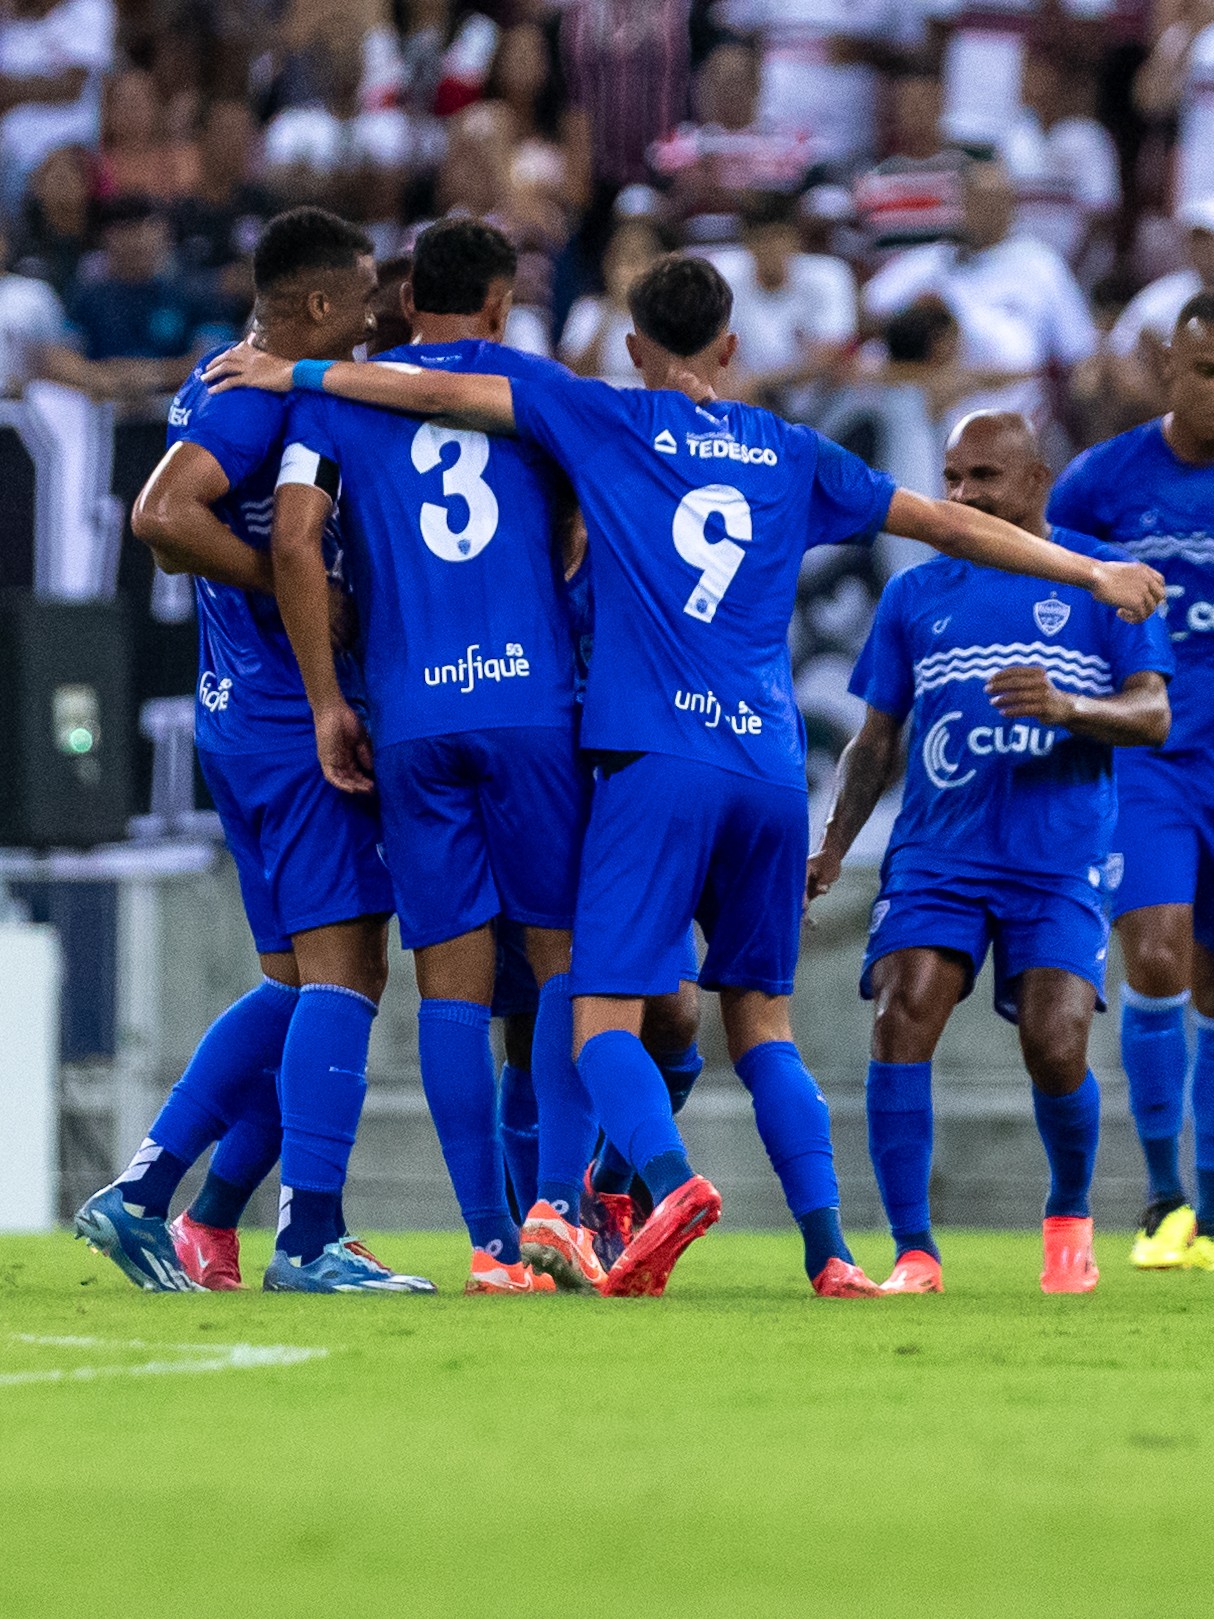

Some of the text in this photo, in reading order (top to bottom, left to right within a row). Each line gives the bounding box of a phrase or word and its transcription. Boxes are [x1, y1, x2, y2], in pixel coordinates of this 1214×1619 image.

[410, 421, 499, 562] 3
[686, 438, 778, 466] TEDESCO
[672, 483, 752, 623] 9
[424, 644, 530, 693] unifique
